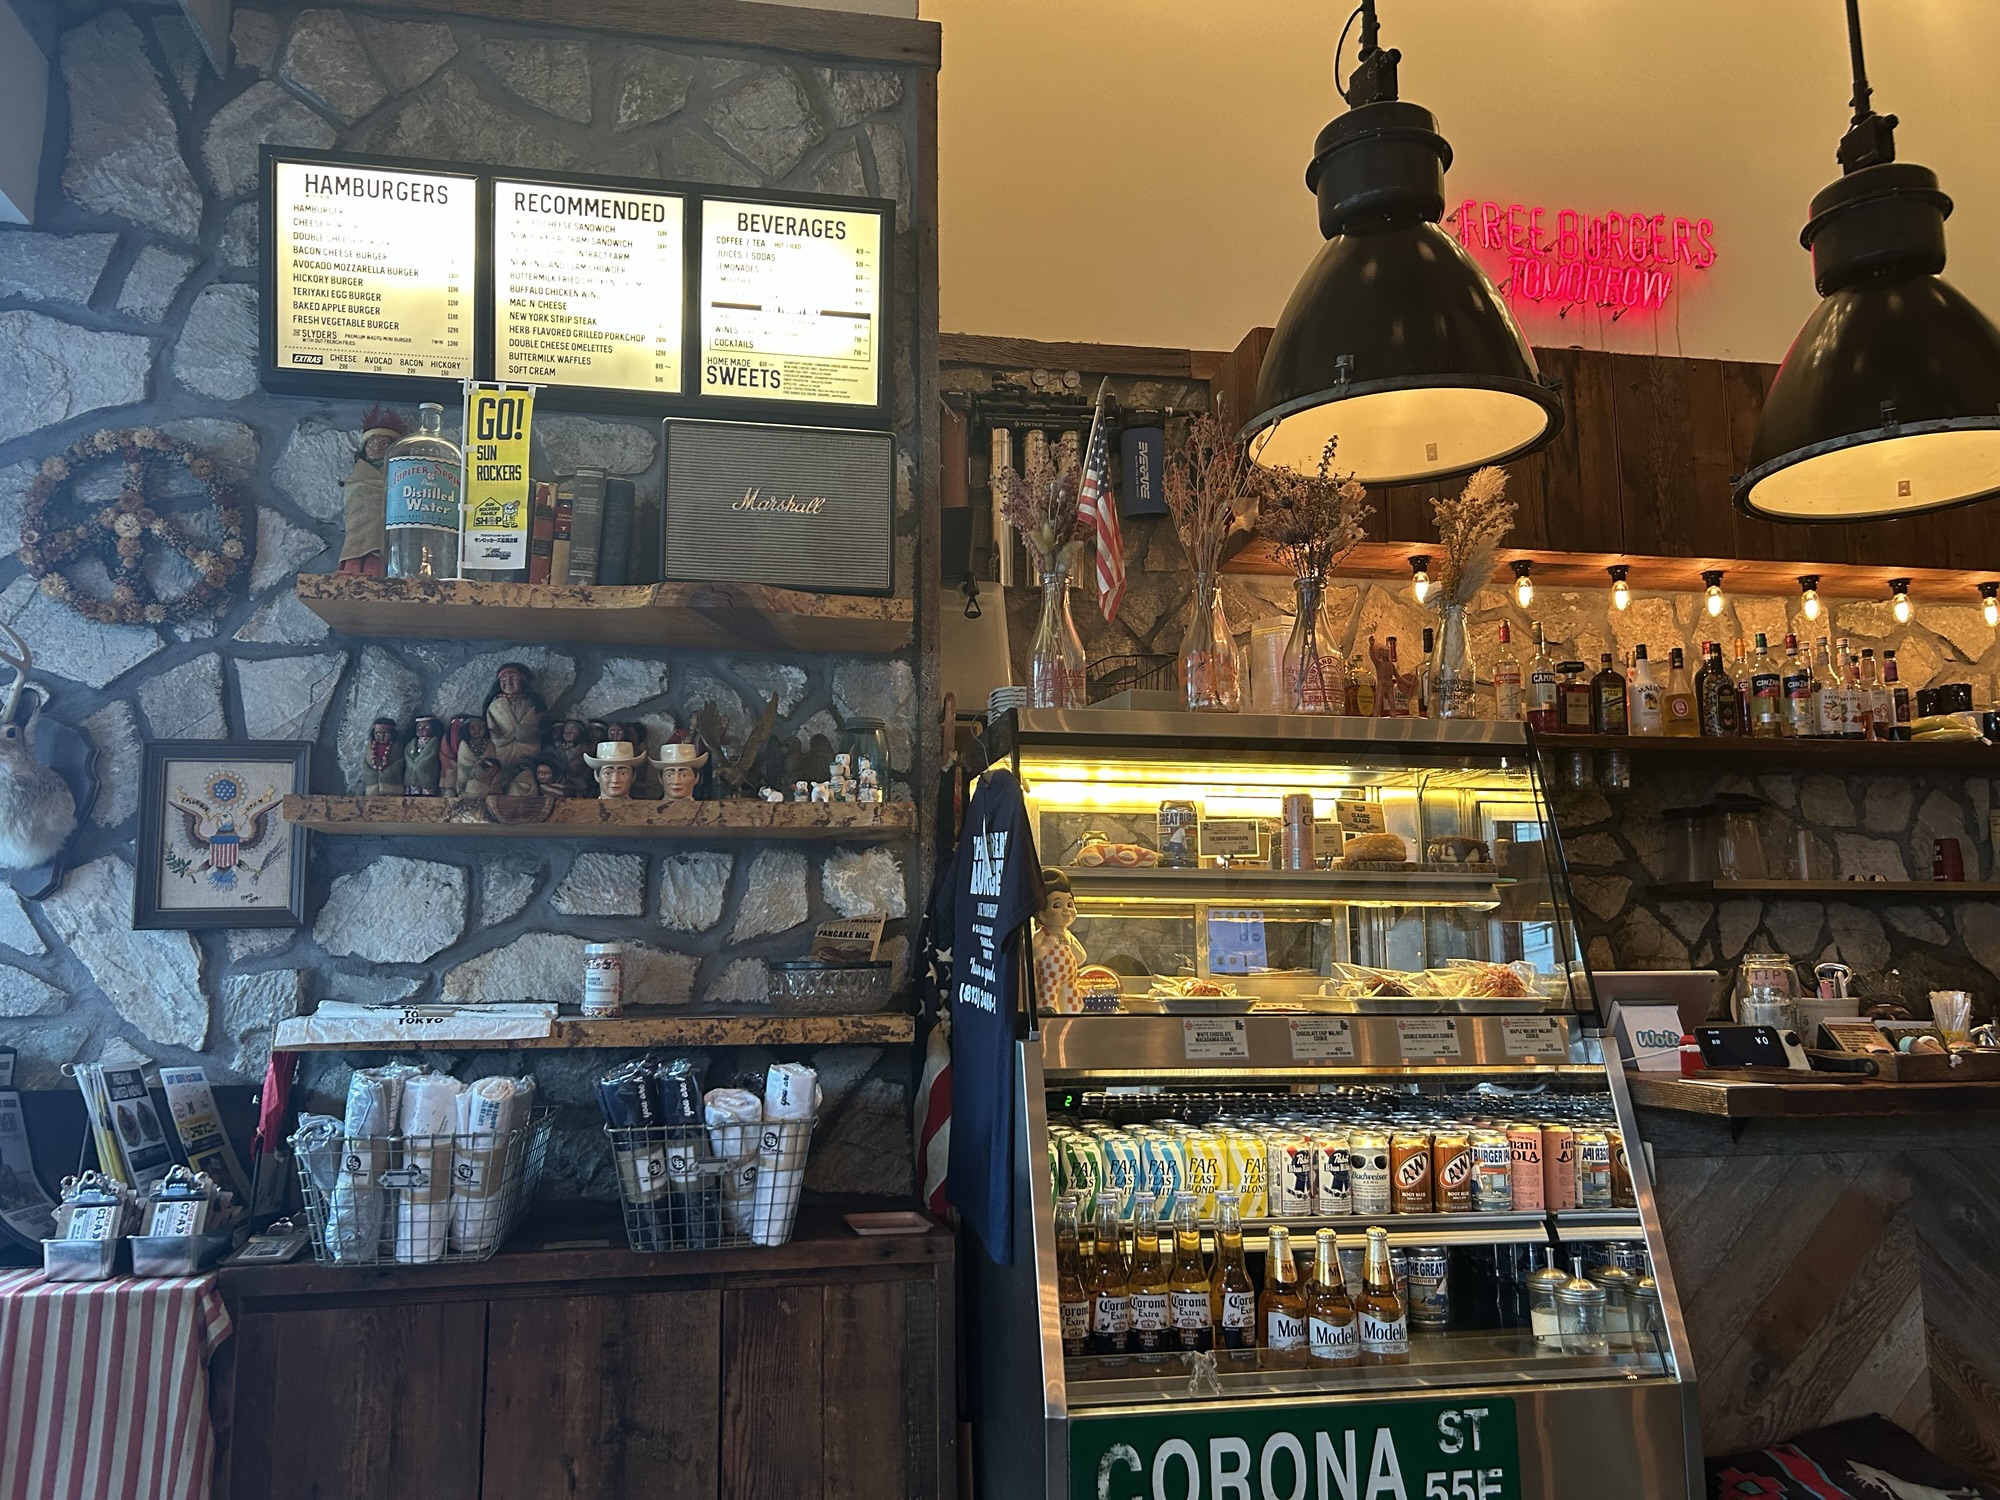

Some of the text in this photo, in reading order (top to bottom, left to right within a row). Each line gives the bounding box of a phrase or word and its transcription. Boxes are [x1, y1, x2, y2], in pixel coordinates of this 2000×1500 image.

[305, 173, 448, 204] HAMBURGERS
[515, 192, 665, 223] RECOMMENDED
[574, 223, 616, 233] SANDWICH
[737, 212, 846, 240] BEVERAGES
[1459, 200, 1716, 268] FREE BURGERS
[591, 238, 633, 249] SANDWICH
[716, 236, 743, 246] COFFEE
[752, 239, 766, 248] TEA
[293, 246, 321, 256] BACON
[323, 248, 353, 258] CHEESE
[716, 250, 776, 262] JUICES SODAS
[293, 260, 419, 277] AVOCADO MOZZARELLA BURGER
[716, 263, 759, 273] LEMONADES
[293, 274, 364, 287] HICKORY BURGER
[510, 272, 555, 283] BUTTERMILK
[1508, 256, 1673, 310] TOMORROW
[293, 287, 381, 302] TERIYAKI EGG BURGER
[510, 285, 544, 295] BUFFALO
[545, 287, 579, 297] CHICKEN
[293, 301, 380, 316] BAKED APPLE BURGER
[510, 299, 567, 310] MAC CHEESE
[293, 315, 400, 331] FRESH VEGETABLE BURGER
[509, 312, 597, 326] NEW YORK STRIP STEAK
[302, 329, 338, 340] SLYDERS
[573, 330, 603, 340] GRILLED
[605, 332, 646, 342] PORKCHOP
[509, 339, 613, 354] DOUBLE CHEESE OMELETTES
[714, 338, 754, 348] COCKTAILS
[293, 354, 461, 370] EXTRAS CHEESE AVOCAD BACON HICKORY
[509, 352, 592, 366] BUTTERMILK WAFFLES
[707, 356, 751, 367] HOME MADE
[508, 365, 556, 377] SOFT CREAM
[706, 365, 781, 389] SWEETS
[477, 398, 525, 440] GO!
[476, 444, 497, 461] SUN
[476, 465, 522, 481] ROCKERS
[1138, 441, 1151, 500] EVERPURE
[402, 485, 455, 503] Distilled
[731, 486, 826, 514] Marshall
[405, 498, 452, 514] Water
[818, 930, 870, 939] PANCAKE MIX
[1751, 970, 1781, 980] TIP
[399, 1017, 443, 1025] TOKYO
[1636, 1030, 1680, 1047] Wolt
[1064, 1095, 1073, 1107] 2
[1474, 1149, 1503, 1163] BURGER
[1071, 1161, 1098, 1177] FAR
[1110, 1159, 1138, 1175] FAR
[1149, 1159, 1177, 1175] FAR
[1188, 1157, 1218, 1173] FAR
[1288, 1164, 1302, 1173] Blue
[1324, 1163, 1339, 1172] Blue
[1109, 1176, 1138, 1185] YEAST
[1148, 1176, 1177, 1186] YEAST
[1188, 1174, 1218, 1184] YEAST
[1352, 1171, 1388, 1180] Budweiser
[1408, 1261, 1442, 1277] THE GREAT
[1130, 1296, 1167, 1314] Corona
[1171, 1294, 1208, 1309] Corona
[1138, 1310, 1160, 1318] Extra
[1179, 1307, 1201, 1316] Extra
[1316, 1326, 1358, 1345] Modelo
[1364, 1320, 1406, 1340] Modelo
[1437, 1407, 1489, 1453] ST
[1097, 1427, 1408, 1500] CORONA
